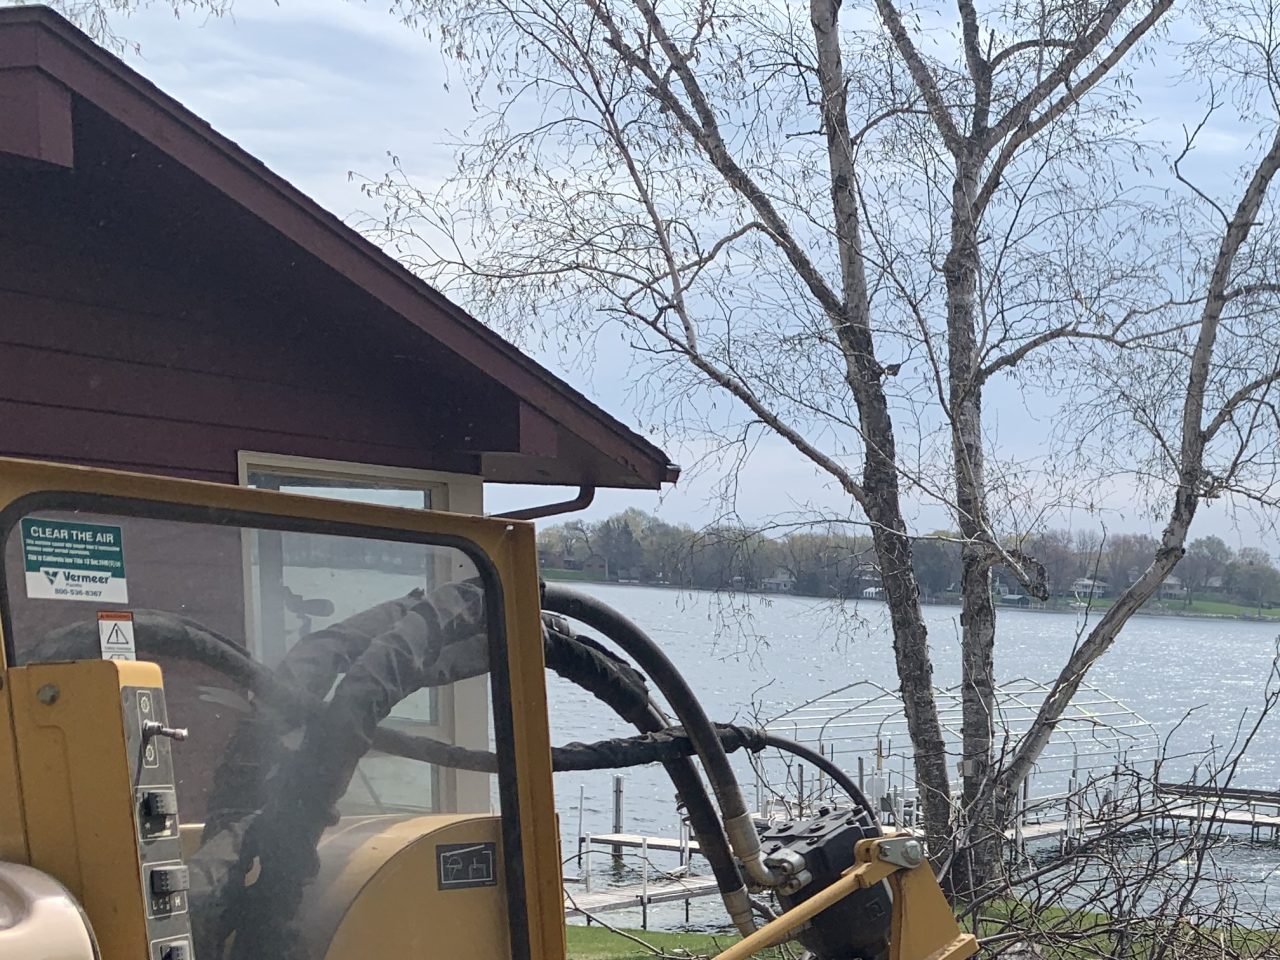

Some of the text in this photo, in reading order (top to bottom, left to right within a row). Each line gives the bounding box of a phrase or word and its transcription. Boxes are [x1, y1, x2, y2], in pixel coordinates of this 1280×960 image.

[30, 526, 114, 544] CLEAR THE AIR
[63, 571, 110, 584] Vermeer
